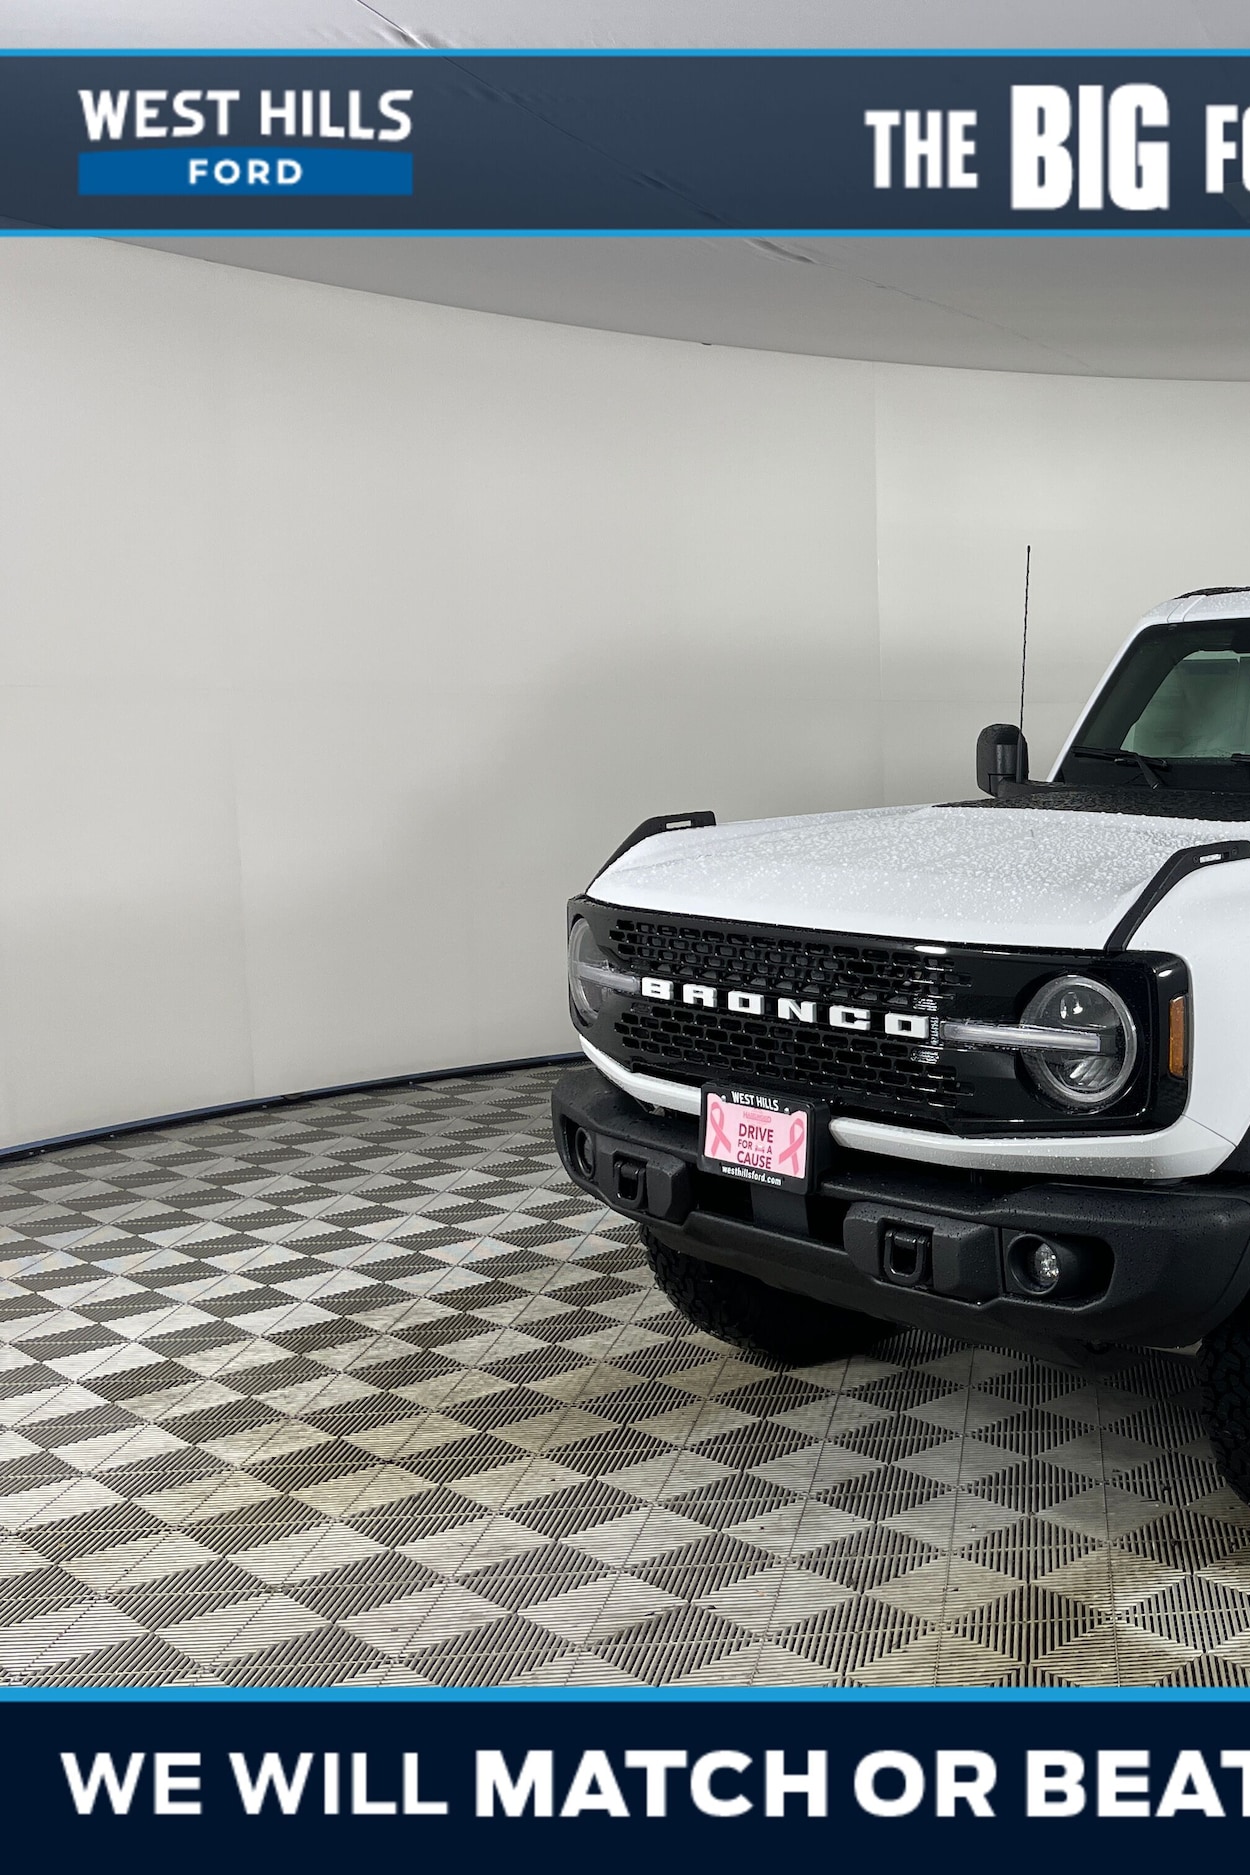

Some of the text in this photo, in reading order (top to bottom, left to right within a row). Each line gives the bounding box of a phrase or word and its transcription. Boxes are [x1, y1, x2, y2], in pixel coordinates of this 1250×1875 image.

[641, 976, 931, 1039] BRONCO
[731, 1090, 779, 1111] WEST HILLS
[738, 1123, 774, 1143] DRIVE
[737, 1138, 773, 1155] FOR A
[736, 1150, 772, 1170] CAUSE
[722, 1165, 782, 1186] westhillsford.com
